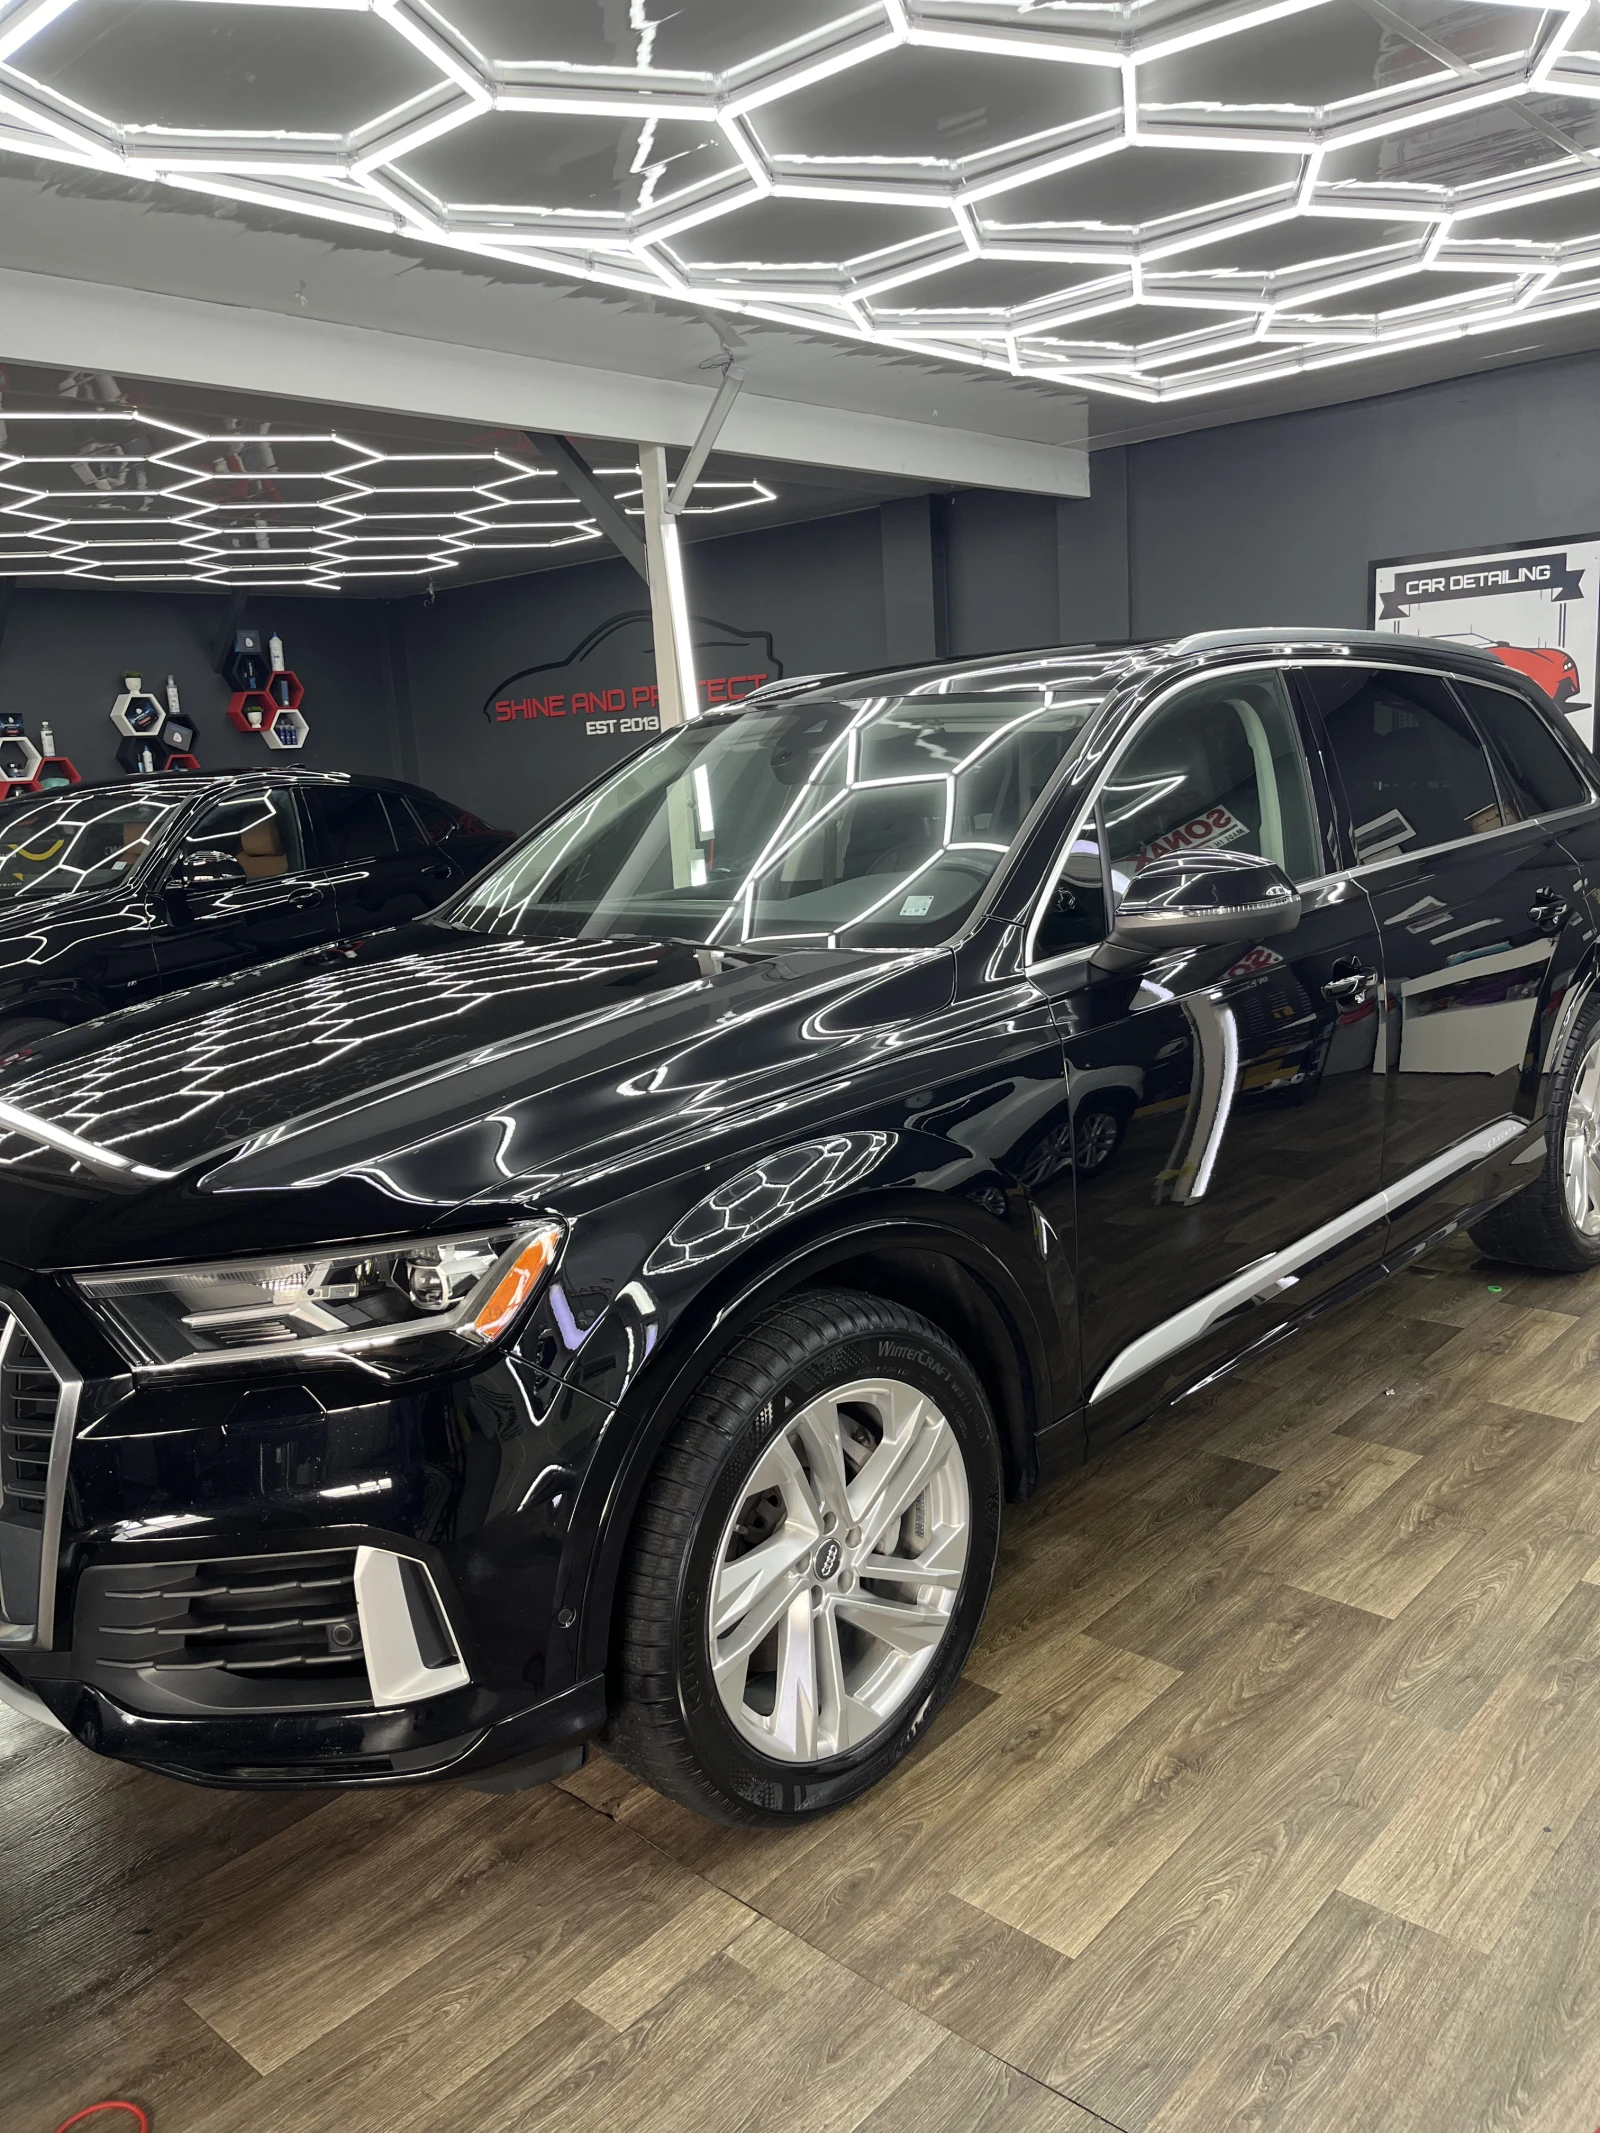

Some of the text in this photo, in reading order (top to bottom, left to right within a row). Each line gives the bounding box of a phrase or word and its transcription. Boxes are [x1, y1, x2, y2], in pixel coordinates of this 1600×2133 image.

[1405, 565, 1551, 595] CAR DETAILING
[495, 673, 768, 721] SHINE AND PTECT
[585, 715, 660, 735] EST 2013
[682, 1589, 705, 1715] KUMHO
